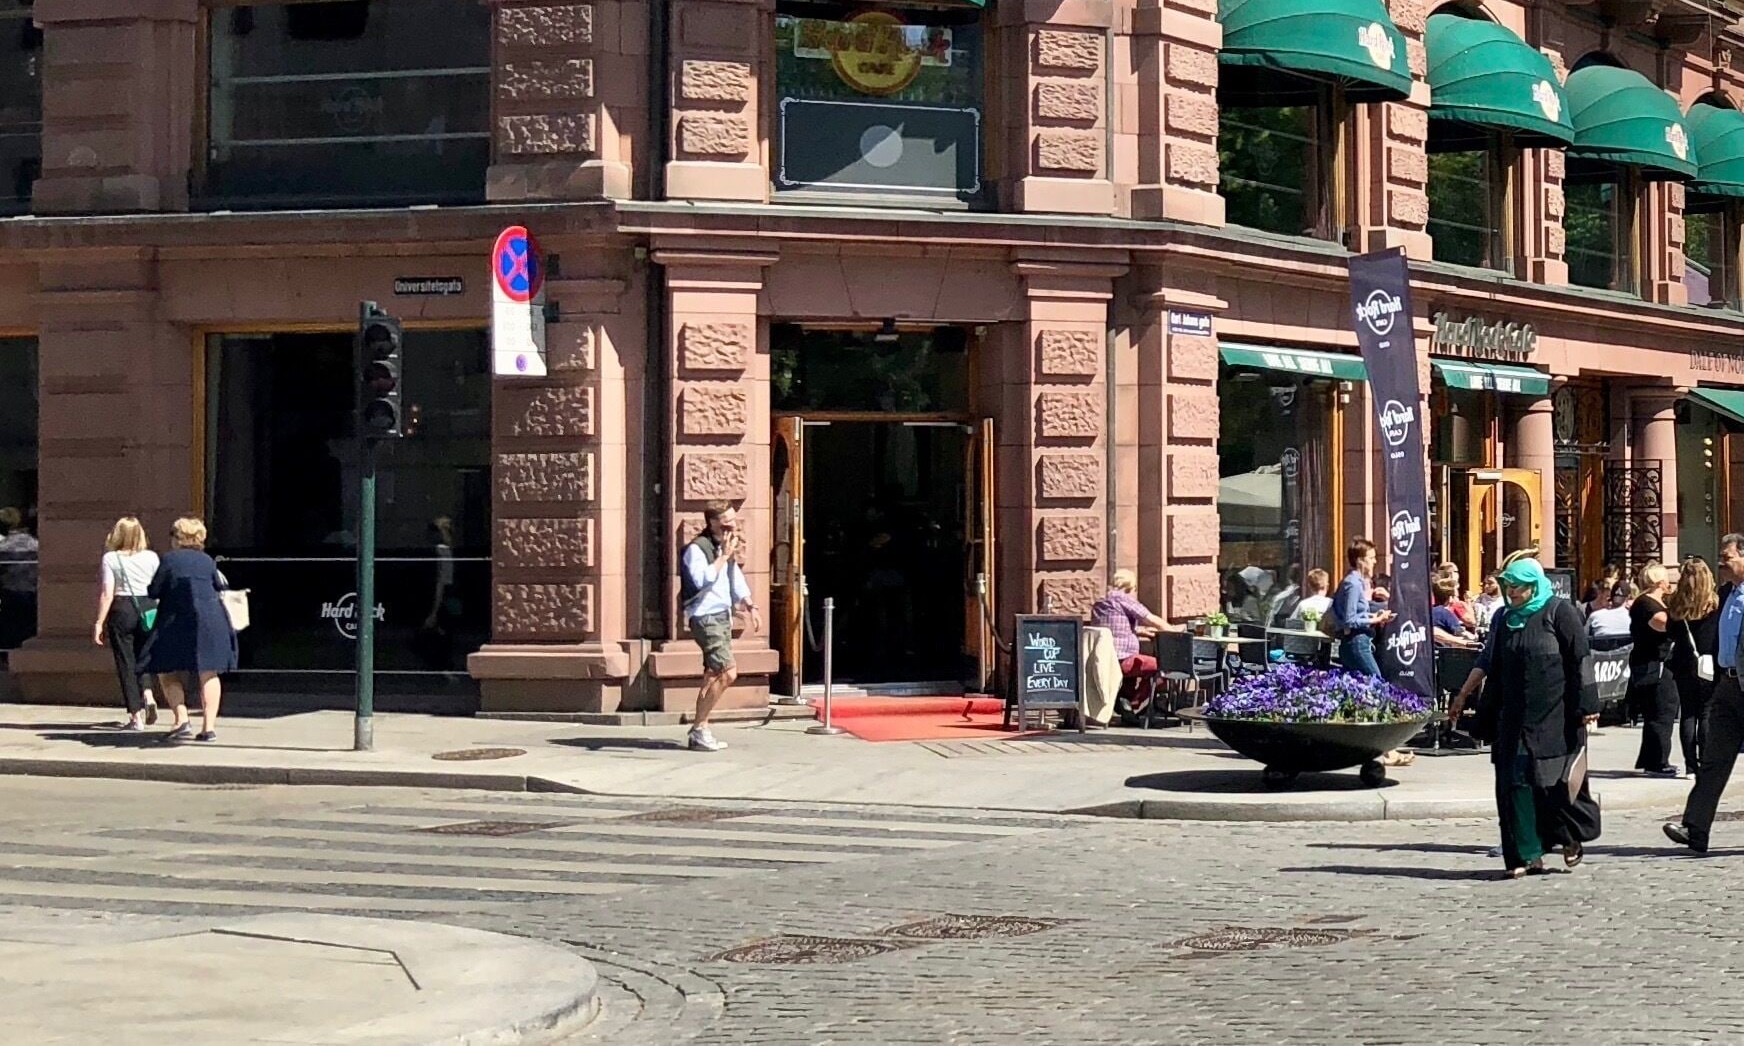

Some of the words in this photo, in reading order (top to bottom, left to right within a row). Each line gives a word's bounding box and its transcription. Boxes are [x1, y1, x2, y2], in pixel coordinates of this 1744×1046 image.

[1690, 349, 1713, 372] DALE
[1714, 352, 1728, 373] OF
[321, 601, 355, 619] Hard
[1043, 648, 1061, 660] CUP
[1033, 662, 1056, 674] LIVE
[1027, 676, 1052, 689] EVERY
[1053, 676, 1069, 688] DAY
